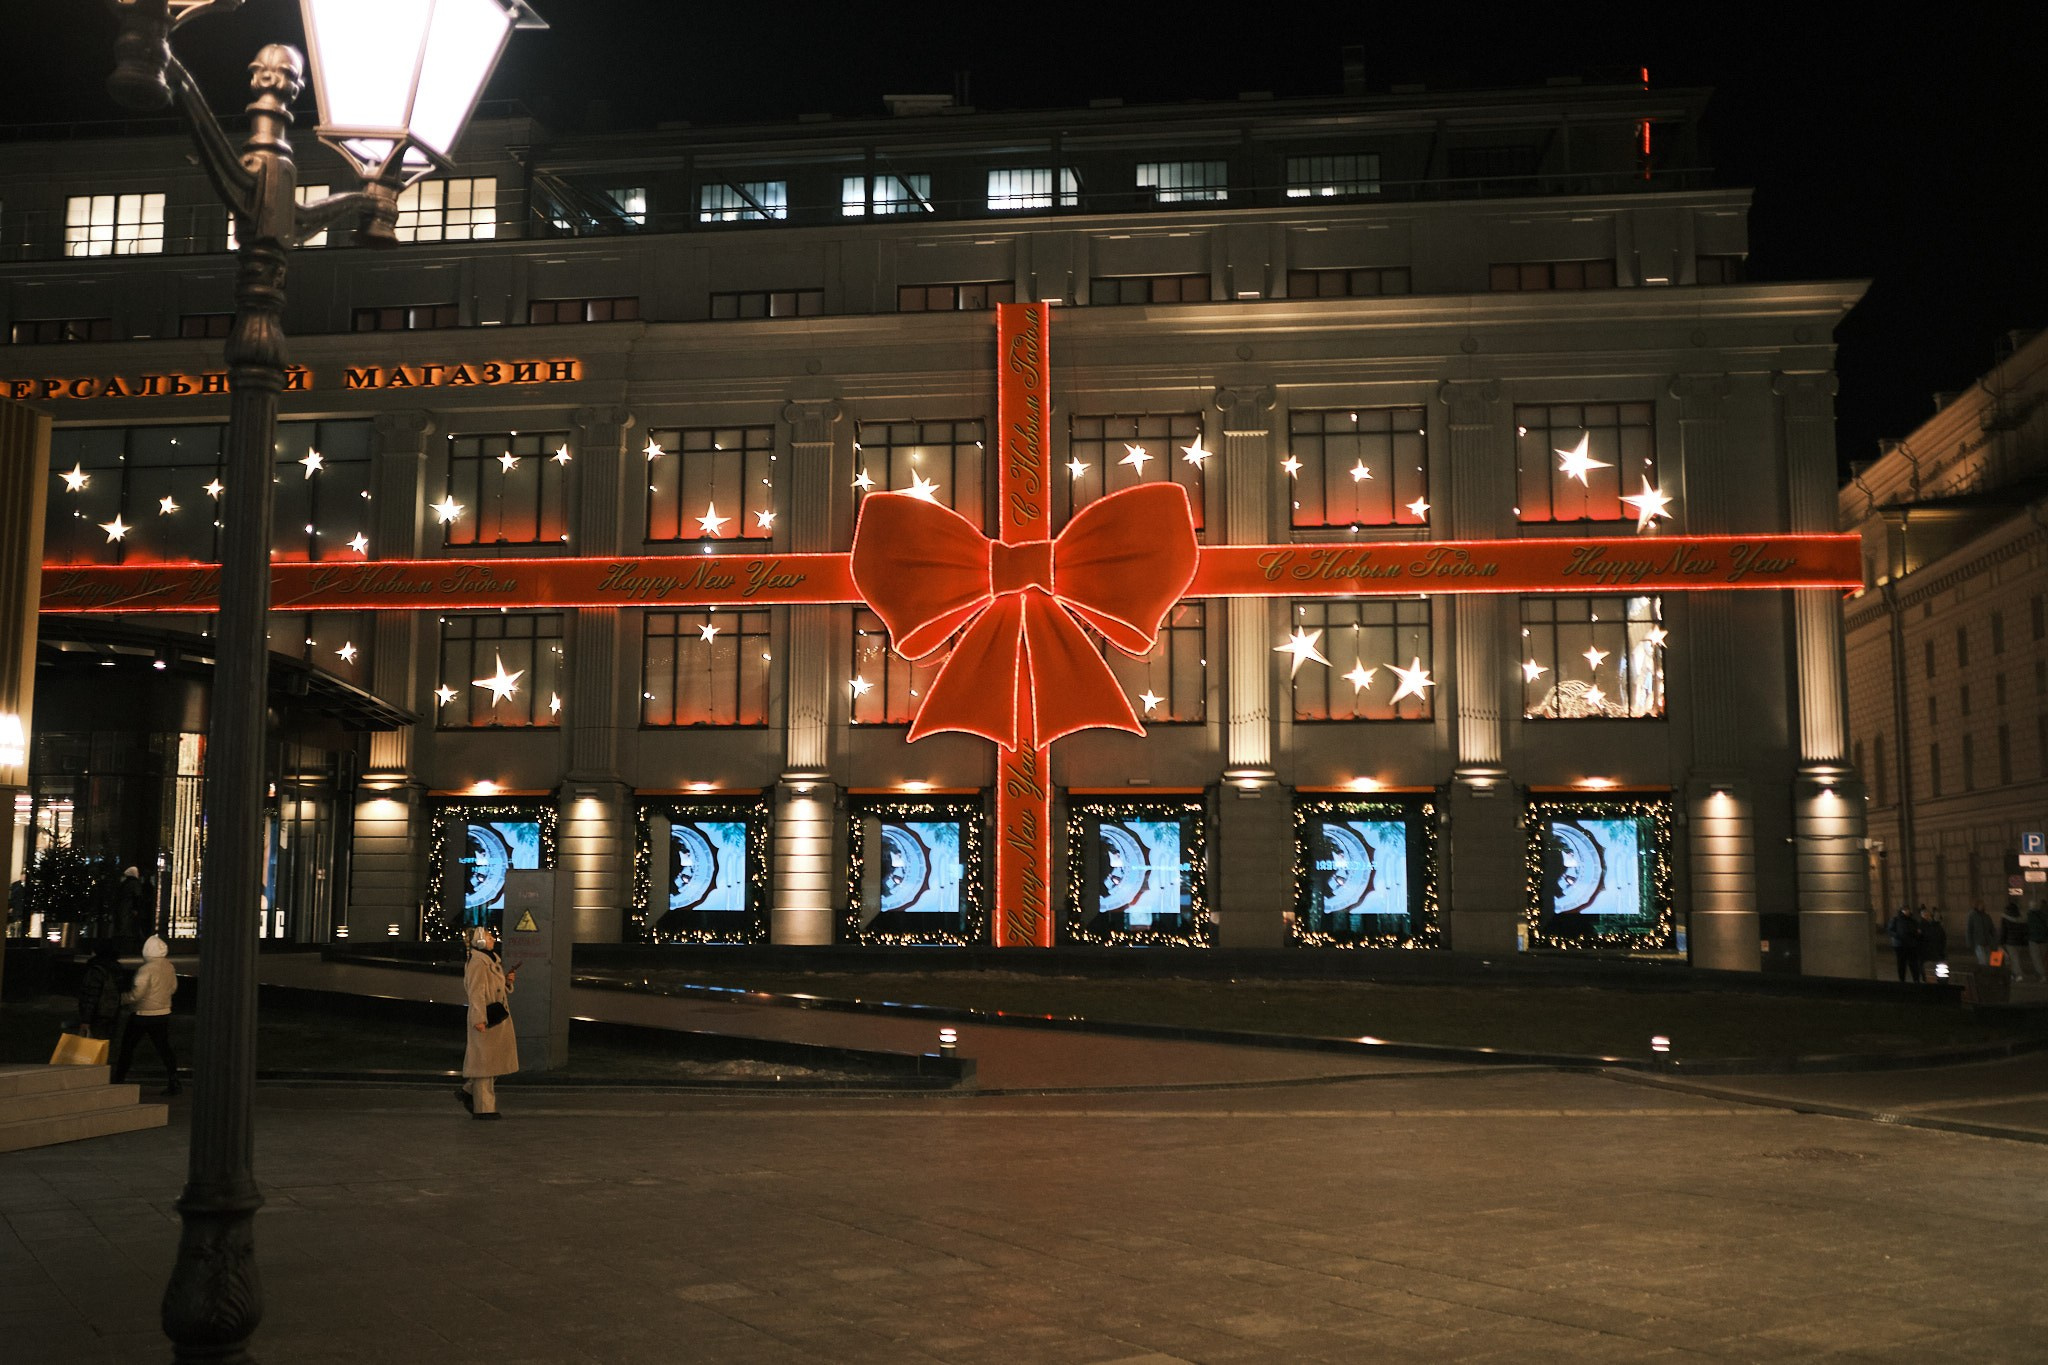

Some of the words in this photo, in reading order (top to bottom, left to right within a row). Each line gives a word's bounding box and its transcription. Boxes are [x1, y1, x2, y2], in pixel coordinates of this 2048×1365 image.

[1009, 307, 1040, 390] Годом
[8, 365, 308, 400] ЕРСАЛЬНЙ
[344, 360, 576, 388] МАГАЗИН
[1010, 394, 1041, 495] Новым
[1010, 492, 1041, 527] С
[340, 565, 433, 593] Новым
[440, 564, 518, 593] Годом
[597, 562, 679, 598] Happy
[679, 560, 735, 591] New
[742, 559, 806, 597] Year
[1257, 550, 1296, 581] С
[1291, 548, 1402, 580] Новым
[1408, 547, 1498, 578] Годом
[1562, 545, 1650, 584] Happy
[1650, 544, 1717, 575] New
[1725, 543, 1797, 583] Year
[1006, 737, 1045, 802] Year
[1006, 808, 1037, 867] New
[2028, 835, 2041, 852] P
[1006, 868, 1046, 946] Happy
